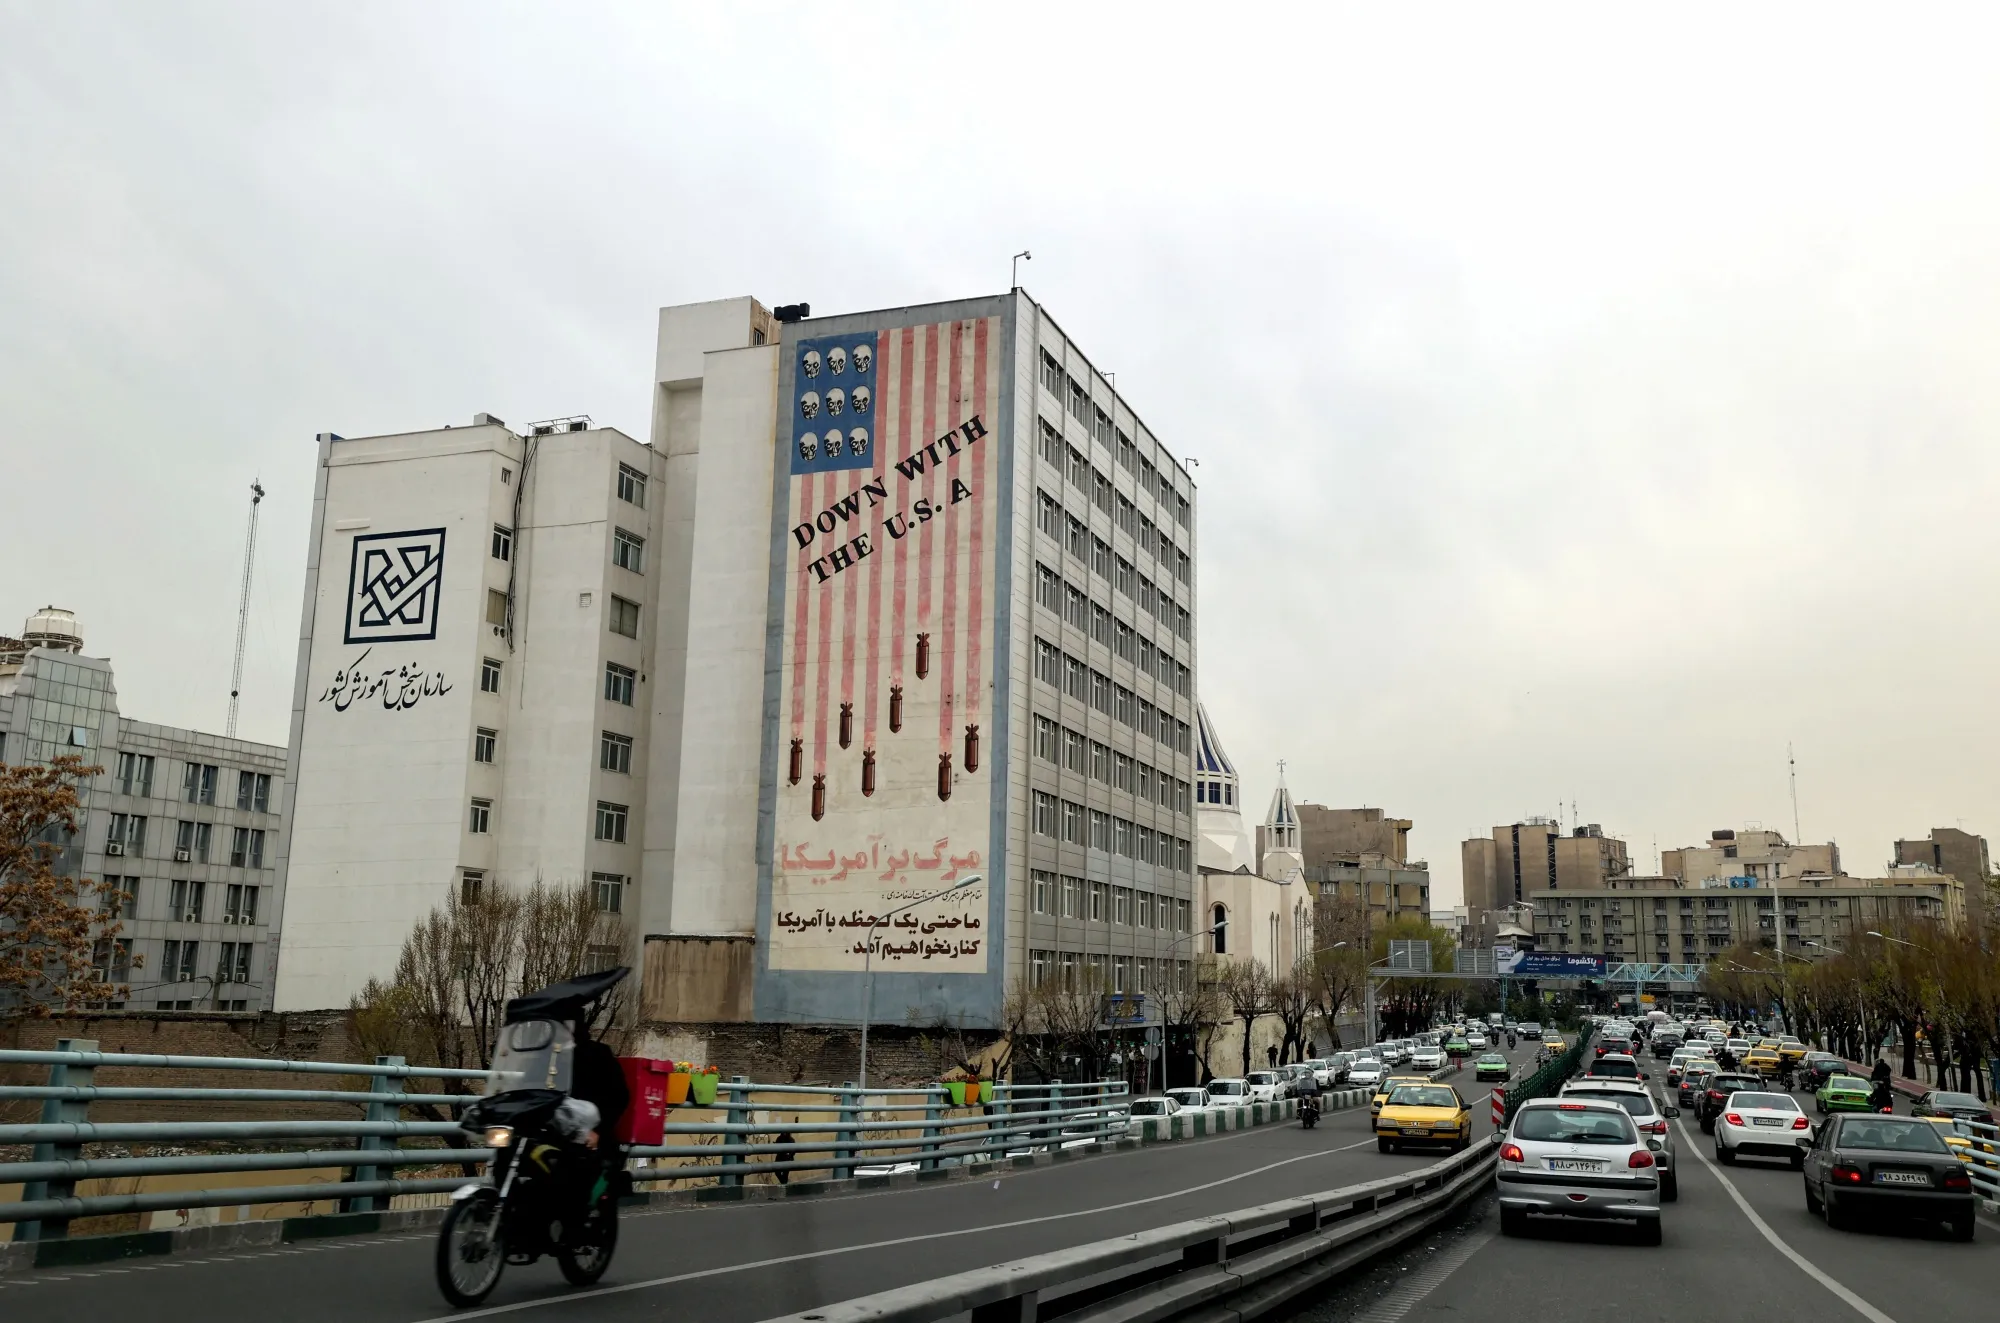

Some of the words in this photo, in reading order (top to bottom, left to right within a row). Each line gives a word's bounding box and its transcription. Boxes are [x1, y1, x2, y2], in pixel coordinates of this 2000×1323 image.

[792, 476, 888, 550] DOWN
[895, 415, 988, 481] WITH
[807, 532, 874, 584] THE
[319, 647, 372, 702] کشور
[384, 661, 423, 711] سنجش
[335, 669, 396, 712] آموزش
[402, 672, 453, 709] سازمان
[781, 833, 885, 886] آمریکا
[879, 848, 910, 885] بر
[913, 837, 981, 881] مرگ
[778, 908, 826, 934] آمریکا
[825, 911, 836, 933] با
[838, 908, 892, 928] لحظه
[894, 912, 919, 934] یک
[921, 914, 962, 934] حتی
[963, 913, 981, 929] ما
[881, 938, 950, 961] نخواهیم
[949, 939, 981, 959] کنار
[1567, 957, 1597, 968] پاکشوما
